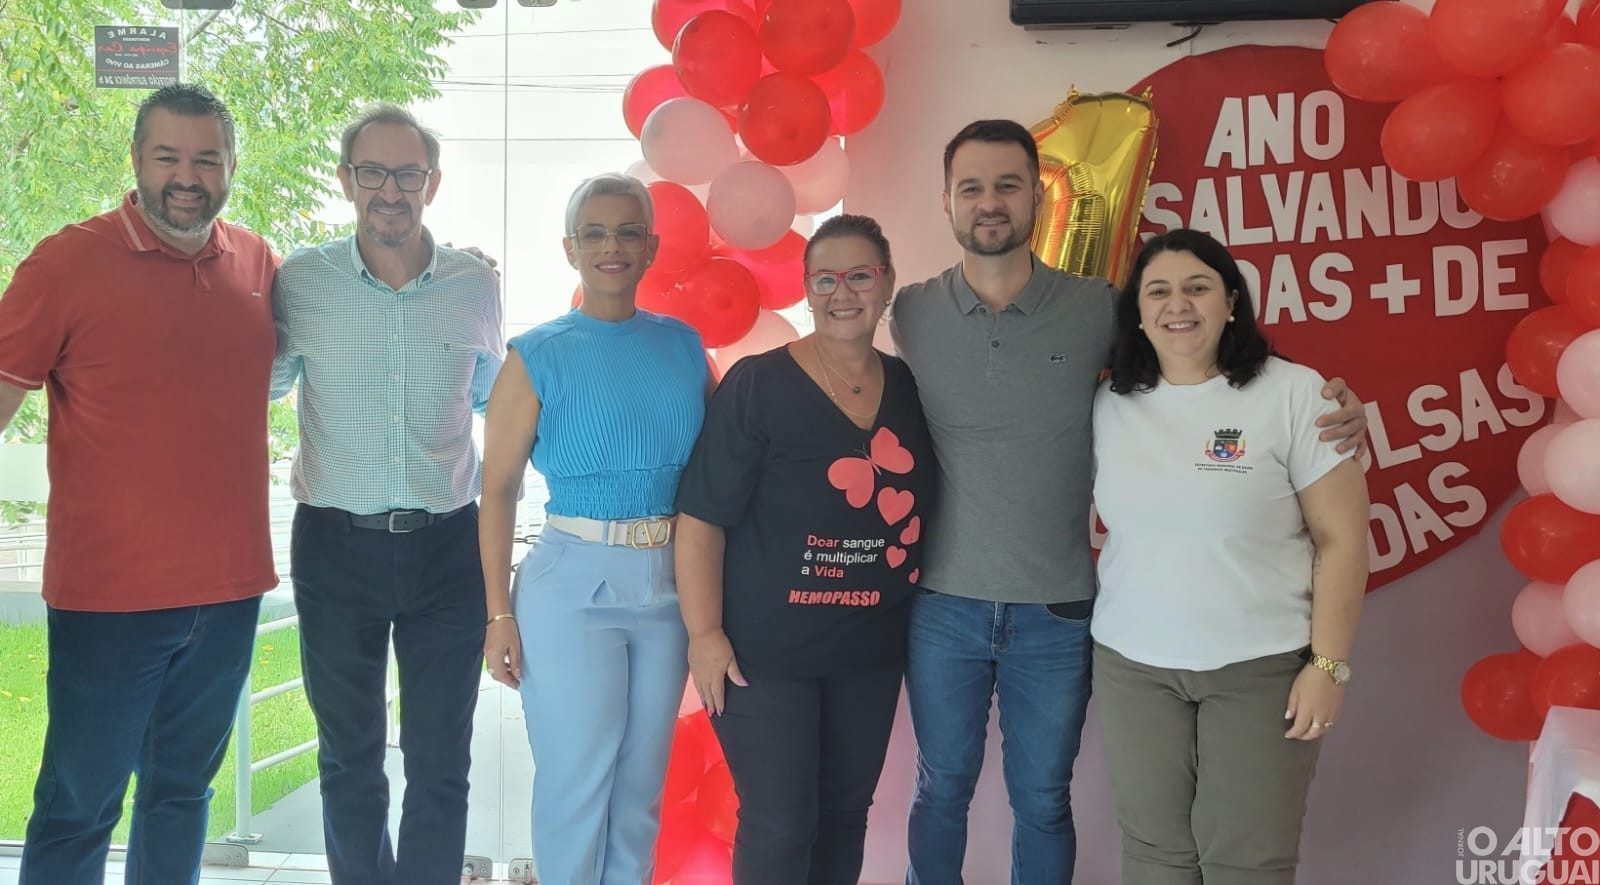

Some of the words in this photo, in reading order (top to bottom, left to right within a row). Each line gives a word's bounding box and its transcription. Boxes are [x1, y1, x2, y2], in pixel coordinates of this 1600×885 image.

[1203, 89, 1346, 170] ANO
[1432, 238, 1530, 318] DE
[1359, 362, 1546, 476] LSAS
[807, 534, 840, 548] Doar
[842, 538, 885, 551] sangue
[803, 549, 813, 561] é
[816, 551, 879, 566] multiplicar
[801, 565, 810, 575] a
[814, 564, 844, 578] Vida
[788, 589, 881, 607] HEMOPASSO
